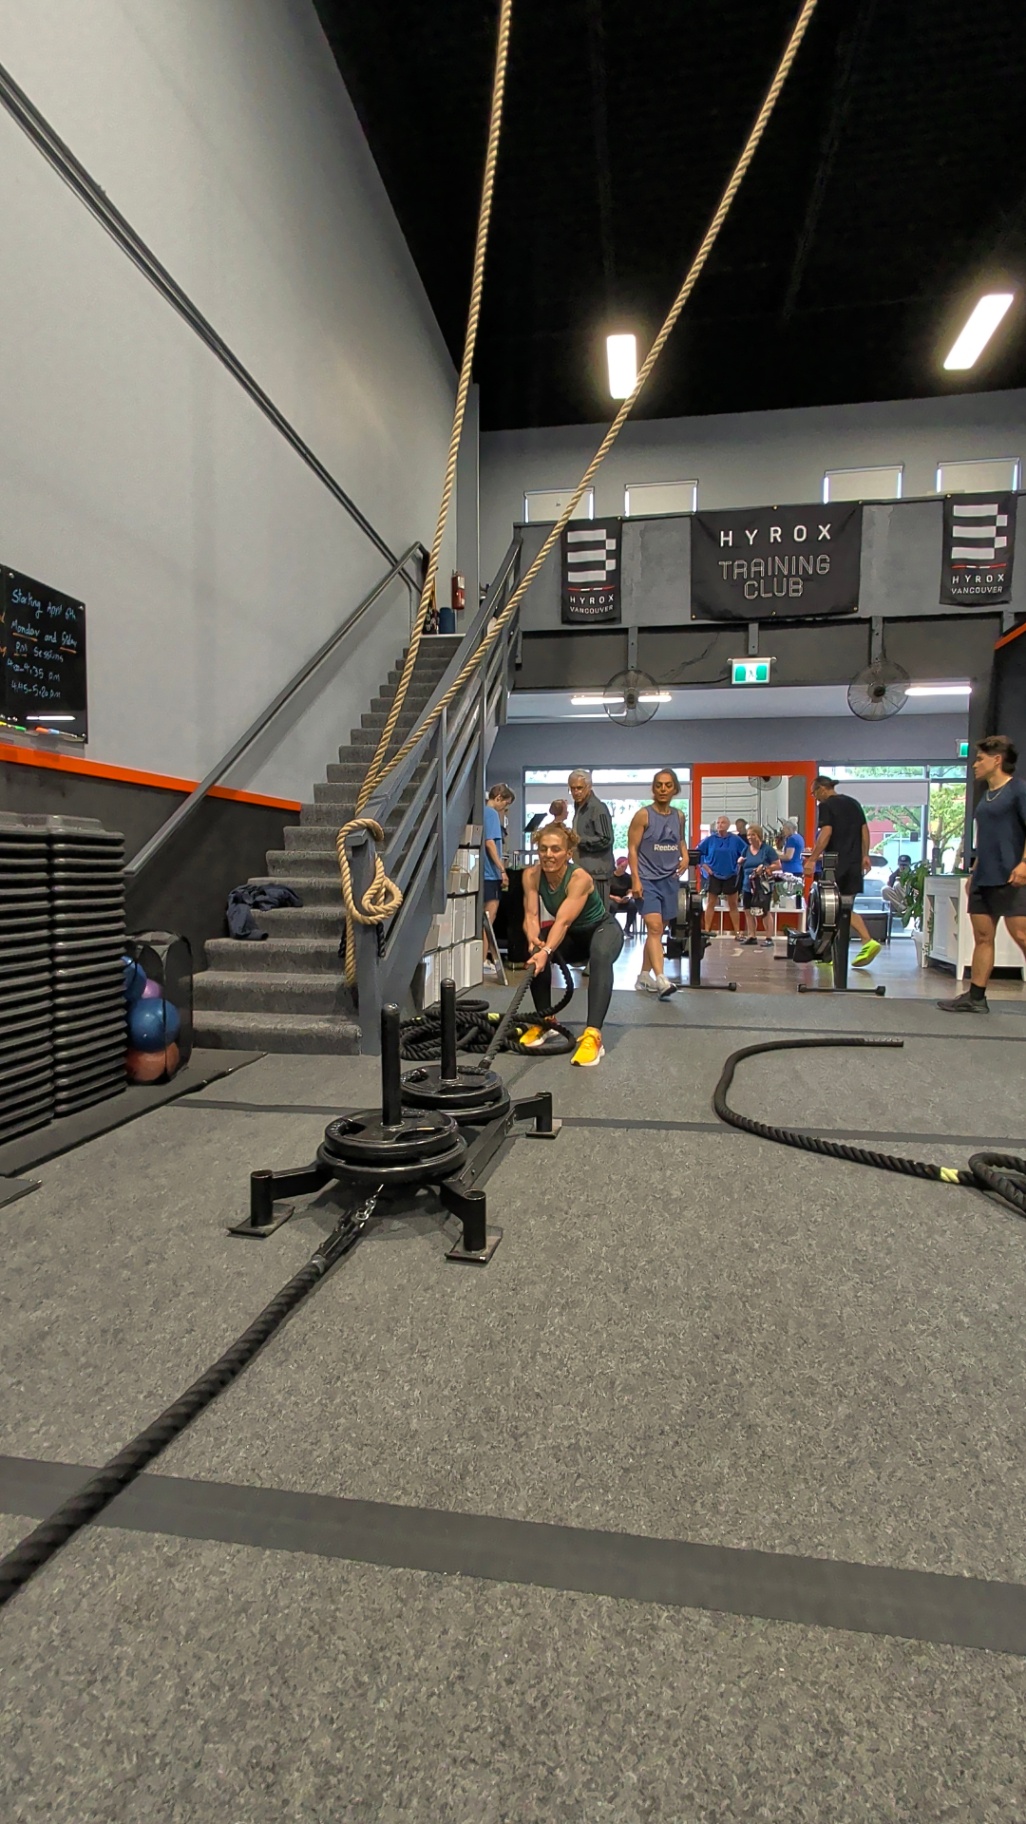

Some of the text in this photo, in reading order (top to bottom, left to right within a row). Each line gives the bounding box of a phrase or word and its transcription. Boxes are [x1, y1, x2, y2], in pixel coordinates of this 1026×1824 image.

[719, 523, 832, 548] HYROX
[718, 554, 831, 581] TRAINING
[951, 573, 1005, 584] HYROX
[744, 577, 804, 600] CLUB
[951, 586, 1003, 595] VANCOUVER
[570, 594, 614, 604] HYROX
[570, 604, 614, 614] VANCOUVER
[11, 619, 41, 637] Monday
[44, 633, 57, 644] and
[653, 843, 679, 851] Reebok
